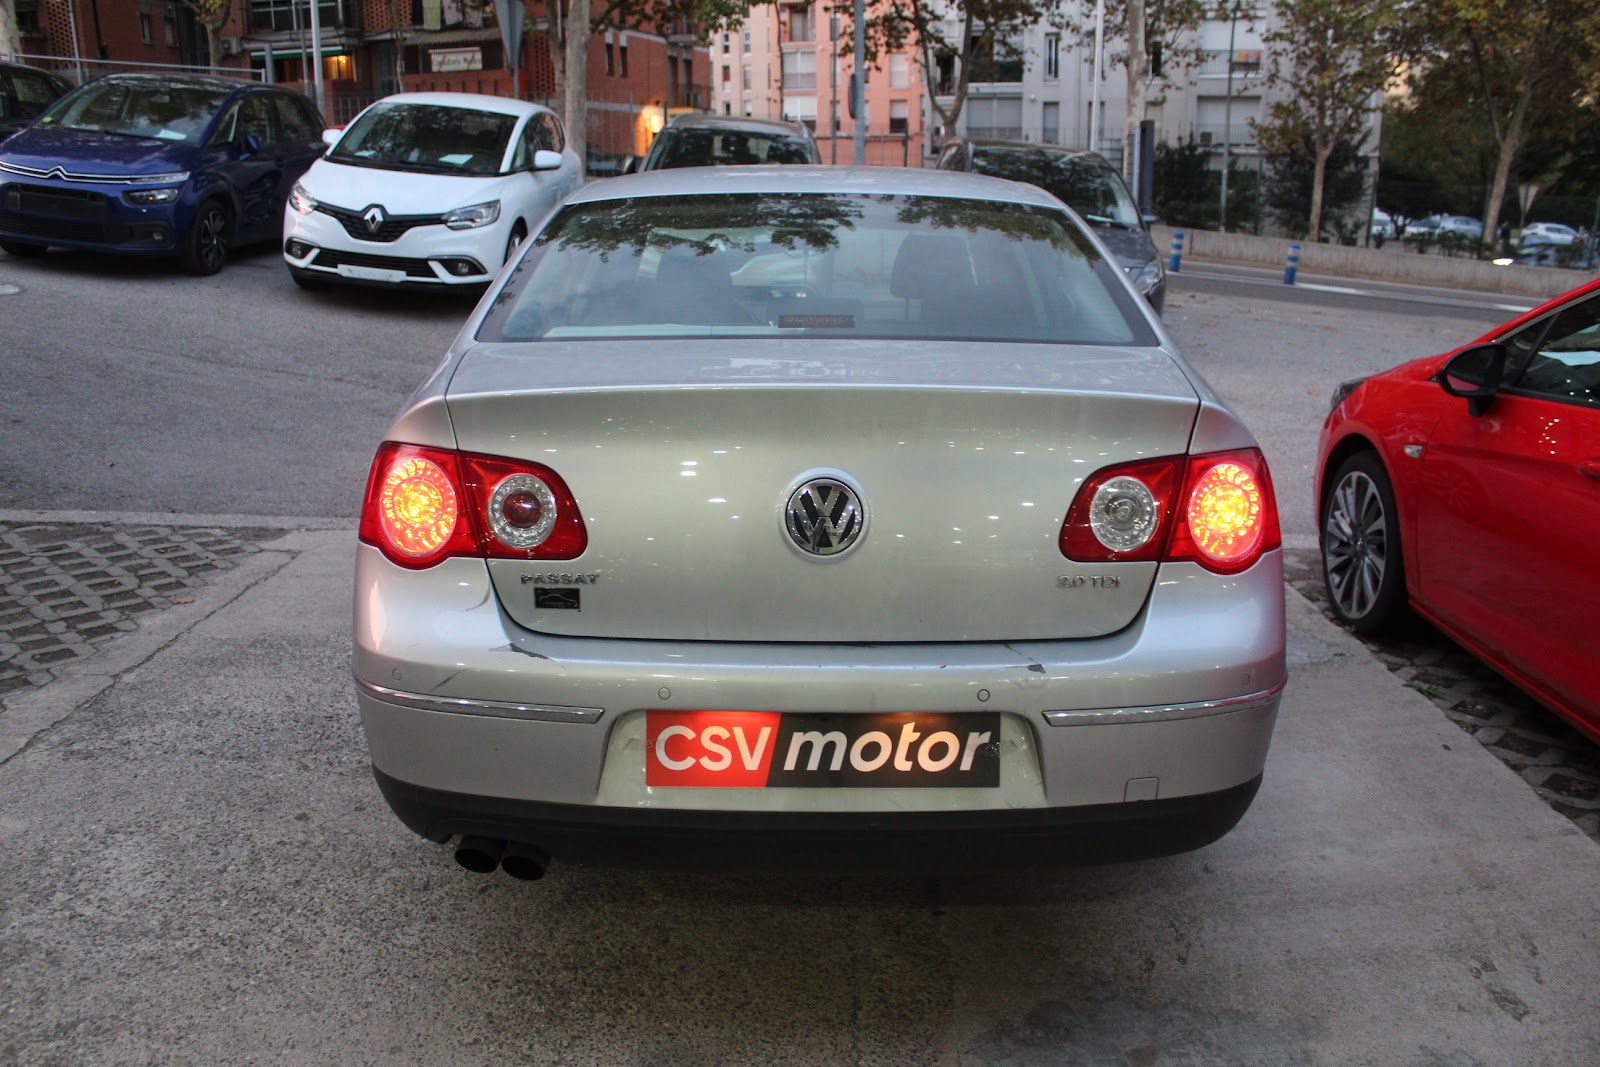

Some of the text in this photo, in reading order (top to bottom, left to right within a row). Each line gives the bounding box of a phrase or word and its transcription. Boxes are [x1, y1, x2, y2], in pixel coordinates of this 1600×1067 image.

[520, 572, 600, 585] PASSAT
[1089, 575, 1121, 589] TDI
[655, 721, 992, 773] CSV motor
